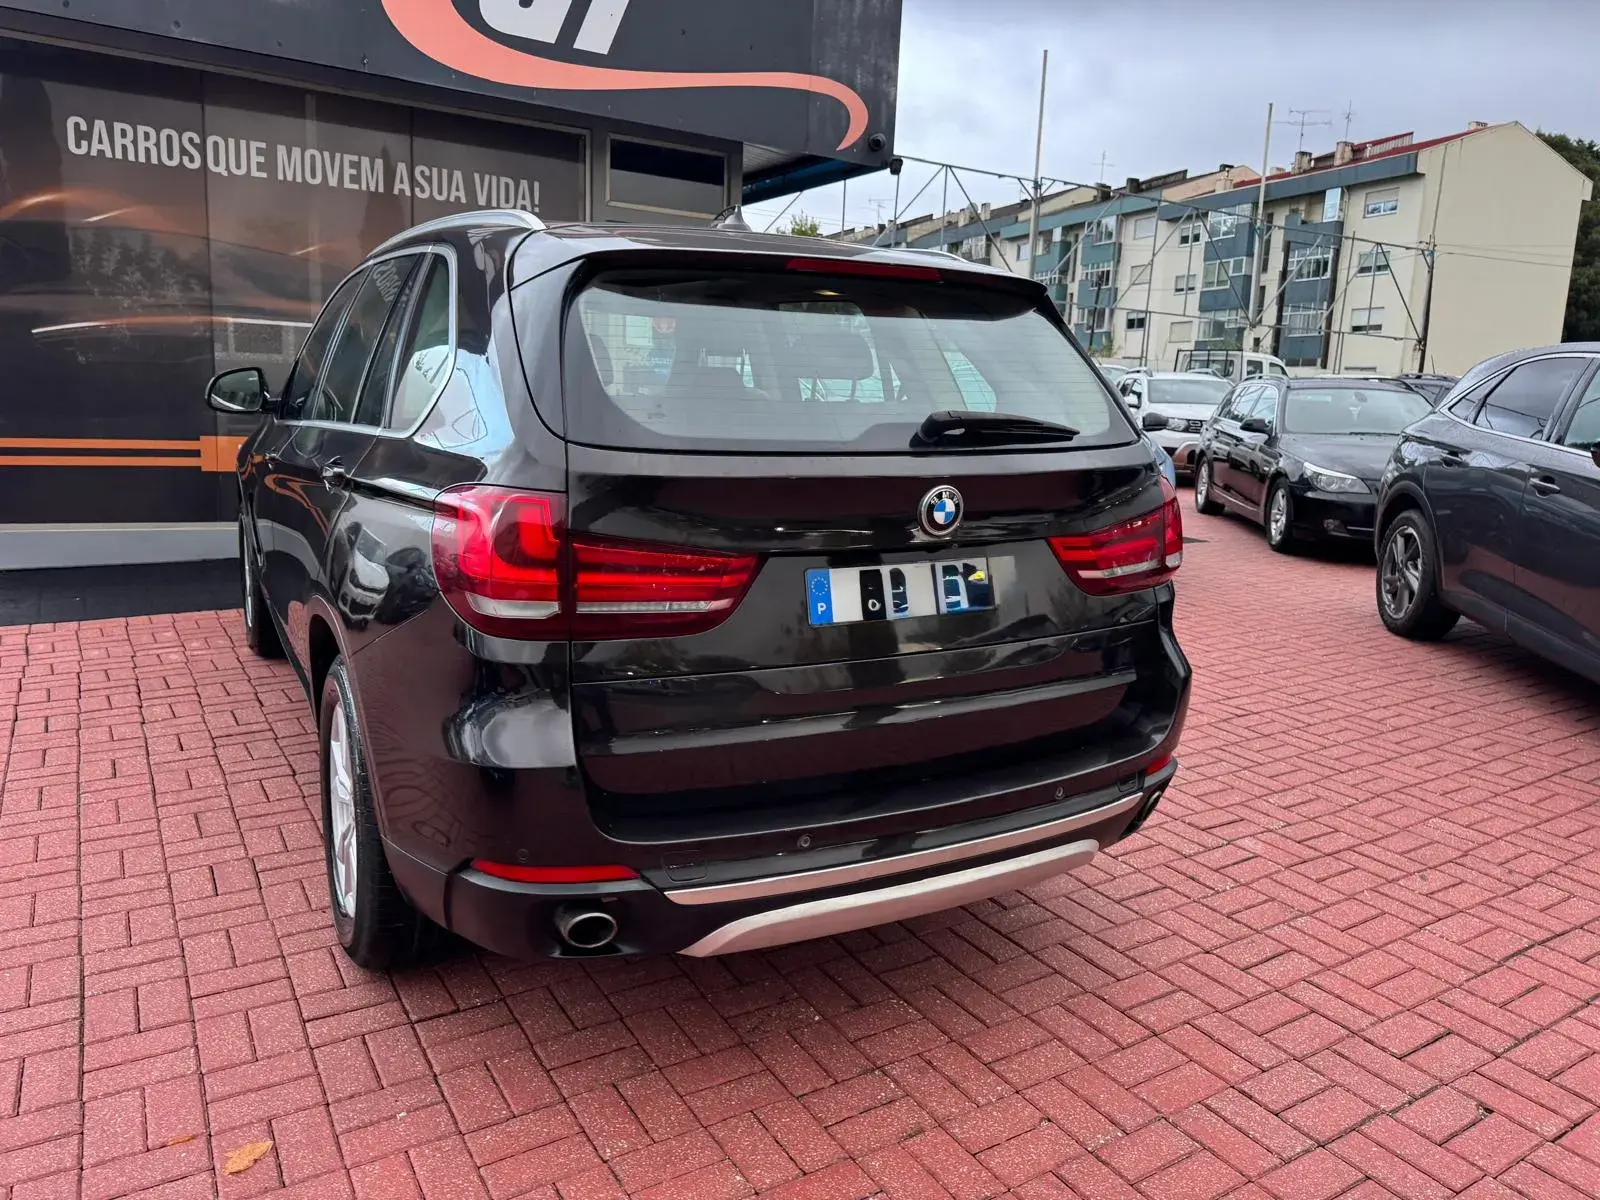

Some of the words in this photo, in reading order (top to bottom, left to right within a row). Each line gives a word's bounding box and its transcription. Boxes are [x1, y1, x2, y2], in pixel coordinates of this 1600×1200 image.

[66, 116, 201, 170] CARROS
[206, 135, 268, 178] QUE
[277, 144, 384, 193] MOVEM
[393, 161, 412, 197] A
[414, 164, 467, 204] SUA
[474, 172, 540, 213] VIDA!
[817, 602, 827, 615] P
